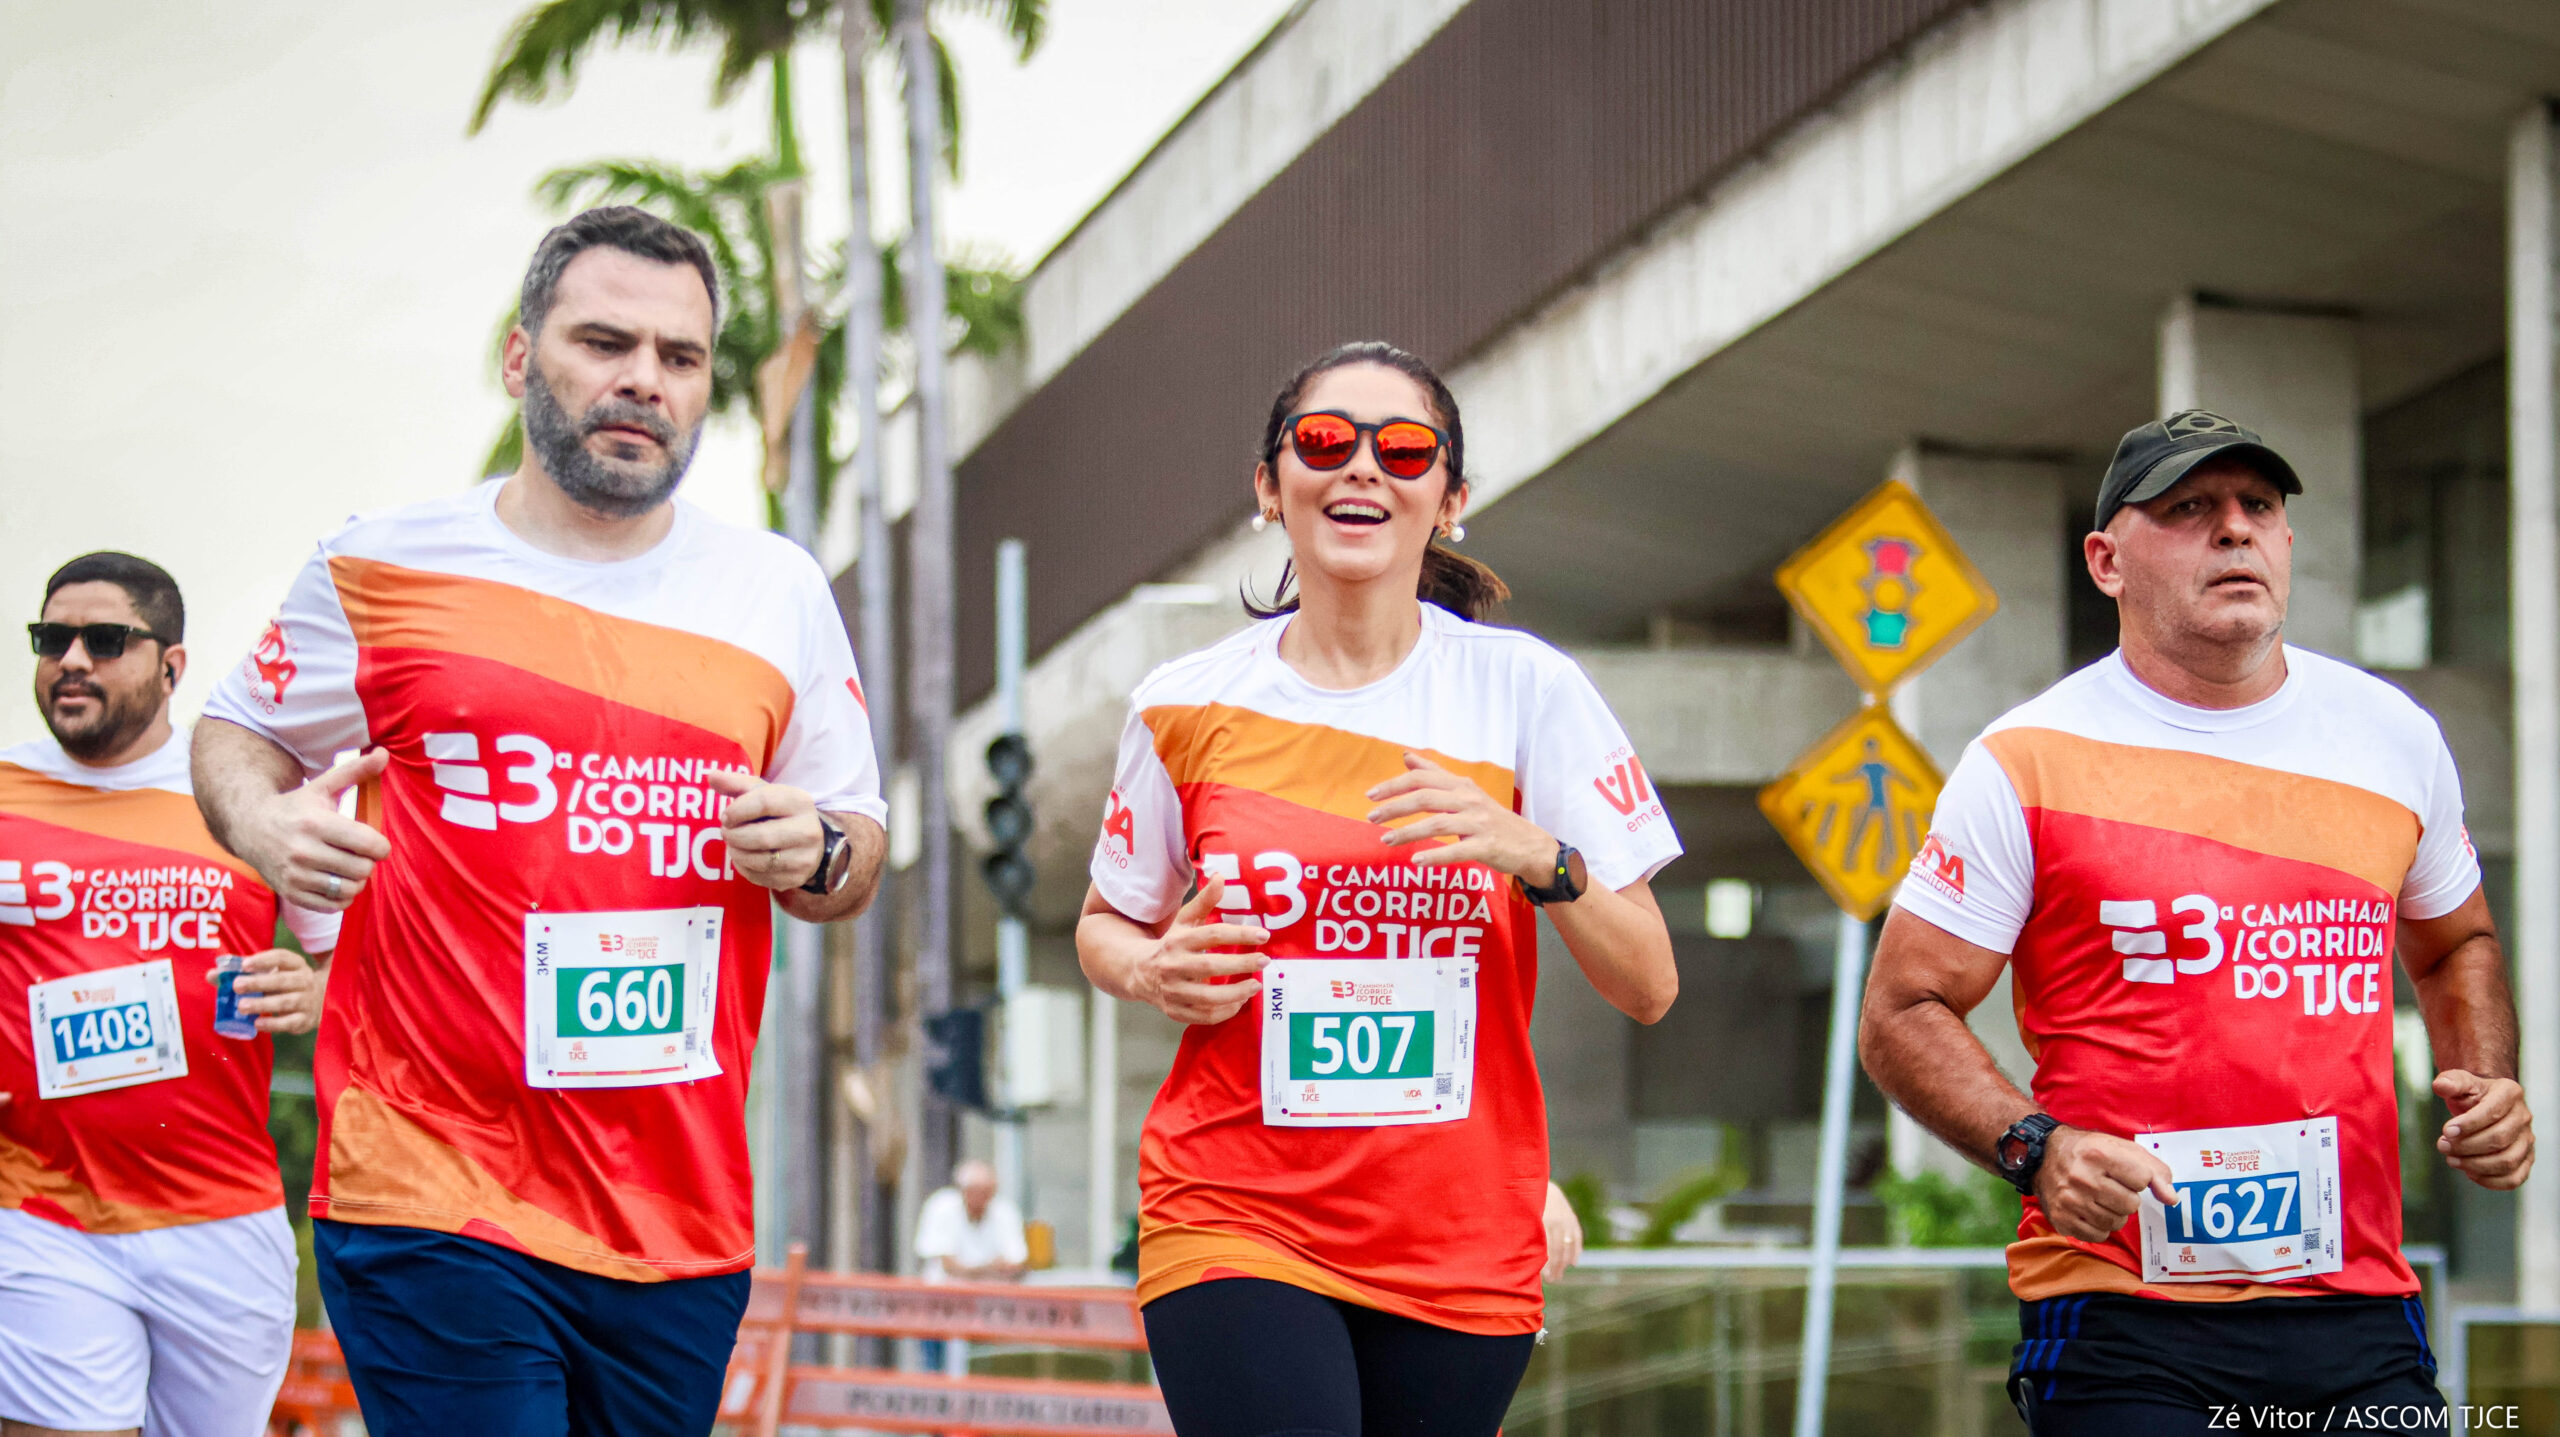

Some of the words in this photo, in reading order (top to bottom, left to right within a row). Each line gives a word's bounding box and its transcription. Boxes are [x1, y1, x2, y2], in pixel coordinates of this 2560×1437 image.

[496, 734, 572, 823] 3ª
[580, 753, 750, 784] CAMINH
[566, 779, 735, 821] /CORRI
[567, 816, 634, 855] DO
[31, 860, 86, 920] 3ª
[89, 865, 234, 890] CAMINHADA
[81, 885, 226, 912] /CORRIDA
[1253, 851, 1319, 930] 3ª
[1326, 864, 1495, 892] CAMINHADA
[1315, 888, 1493, 924] /CORRIDA
[82, 911, 129, 938] DO
[131, 911, 222, 950] TJCE
[1315, 919, 1371, 951] DO
[2171, 894, 2235, 975] 3ª
[2241, 899, 2390, 927] CAMINHADA
[2232, 926, 2384, 962] /CORRIDA
[536, 942, 549, 976] 3KM
[577, 968, 674, 1032] 660
[1272, 987, 1284, 1021] 3KM
[1369, 995, 1393, 1005] TJCE
[2234, 963, 2288, 999] DO
[2294, 963, 2381, 1016] TJCE
[54, 1004, 152, 1059] 1408
[1311, 1015, 1416, 1075] 507
[1301, 1093, 1320, 1102] TJCE
[2237, 1161, 2259, 1172] TJCE
[2172, 1176, 2298, 1239] 1627
